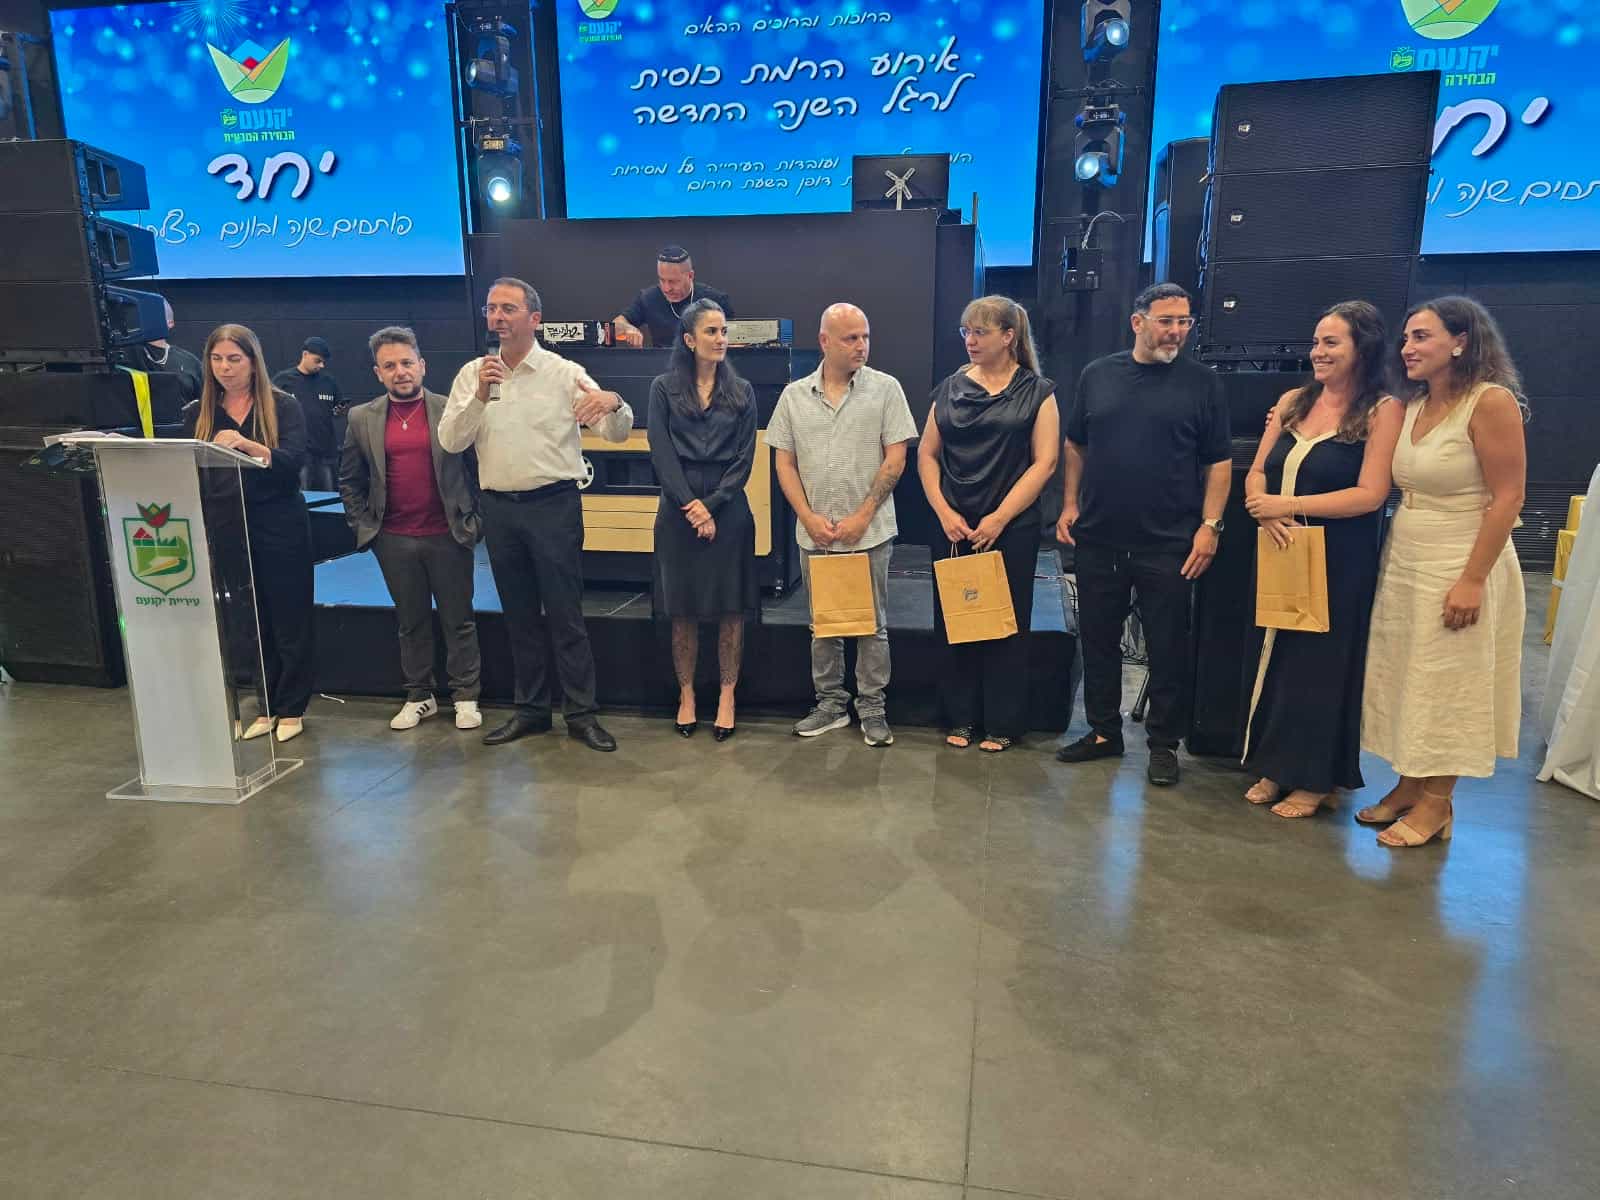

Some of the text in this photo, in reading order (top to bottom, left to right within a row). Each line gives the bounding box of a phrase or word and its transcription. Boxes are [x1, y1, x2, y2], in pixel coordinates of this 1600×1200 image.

[684, 11, 891, 36] ברוכות וברוכים הבאים
[630, 36, 959, 90] אירוע הרמת כוסית
[1416, 45, 1499, 72] יקנעם
[1445, 73, 1497, 86] הבחירה
[633, 73, 975, 130] לרגל השנה החדשה
[239, 107, 293, 130] יקנעם
[1432, 97, 1549, 156] יח
[261, 131, 295, 141] הבחירה
[207, 150, 335, 199] יחד
[612, 163, 668, 176] מסירות
[678, 156, 695, 174] על
[706, 161, 764, 174] העירייה
[687, 180, 732, 192] חירום
[741, 178, 788, 190] בשעת
[795, 176, 832, 196] דופן
[1445, 179, 1516, 218] שנה
[220, 215, 278, 248] ובונים
[283, 216, 329, 247] שנה
[332, 211, 413, 239] פותחים
[135, 596, 200, 607] עיריית יקנעם
